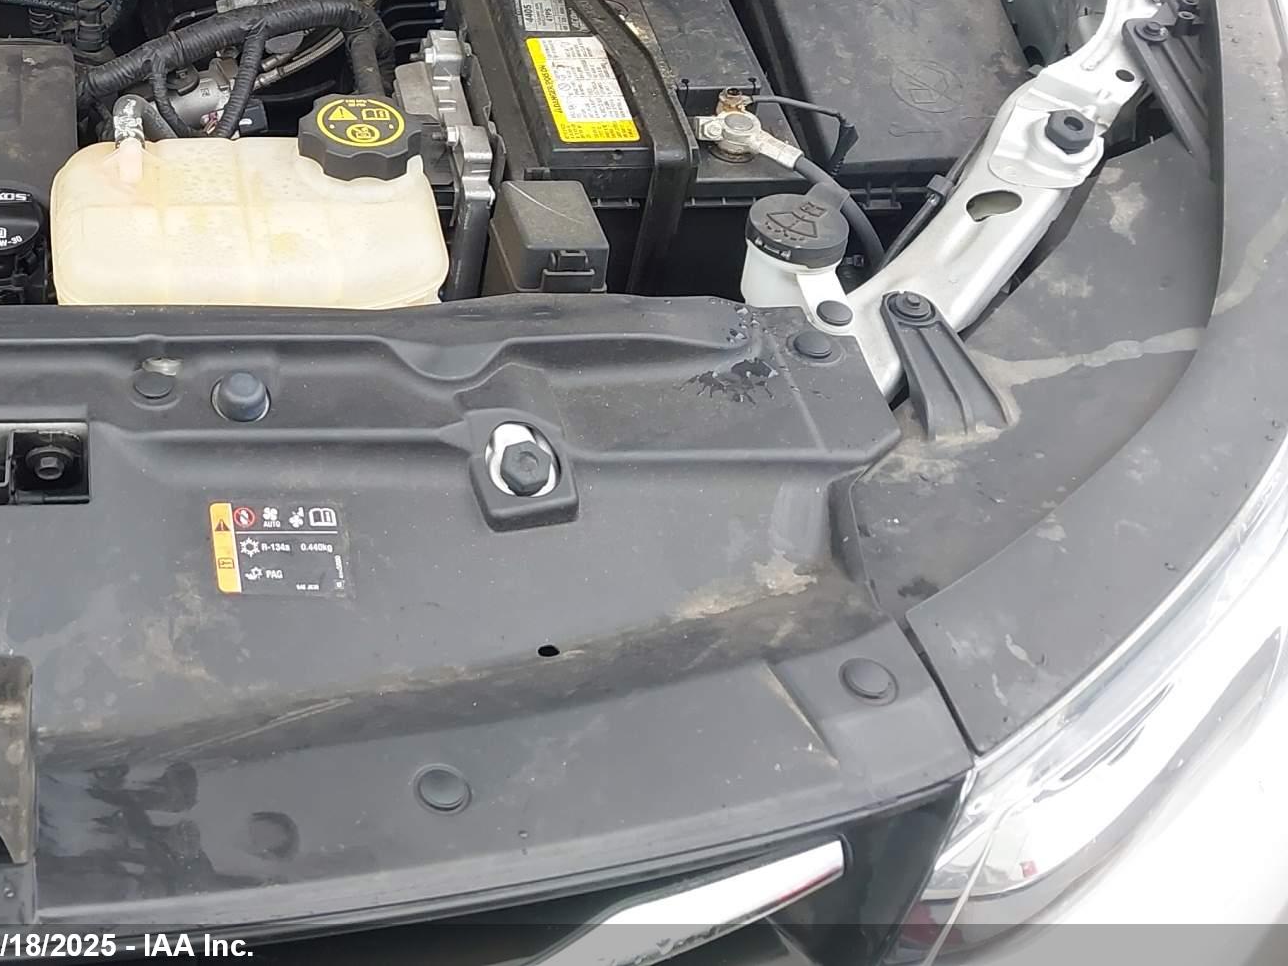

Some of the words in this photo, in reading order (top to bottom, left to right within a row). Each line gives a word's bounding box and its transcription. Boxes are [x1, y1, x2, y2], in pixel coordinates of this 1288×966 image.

[261, 543, 290, 551] R-134a
[300, 543, 333, 553] 0.440kg
[265, 570, 283, 579] PAG
